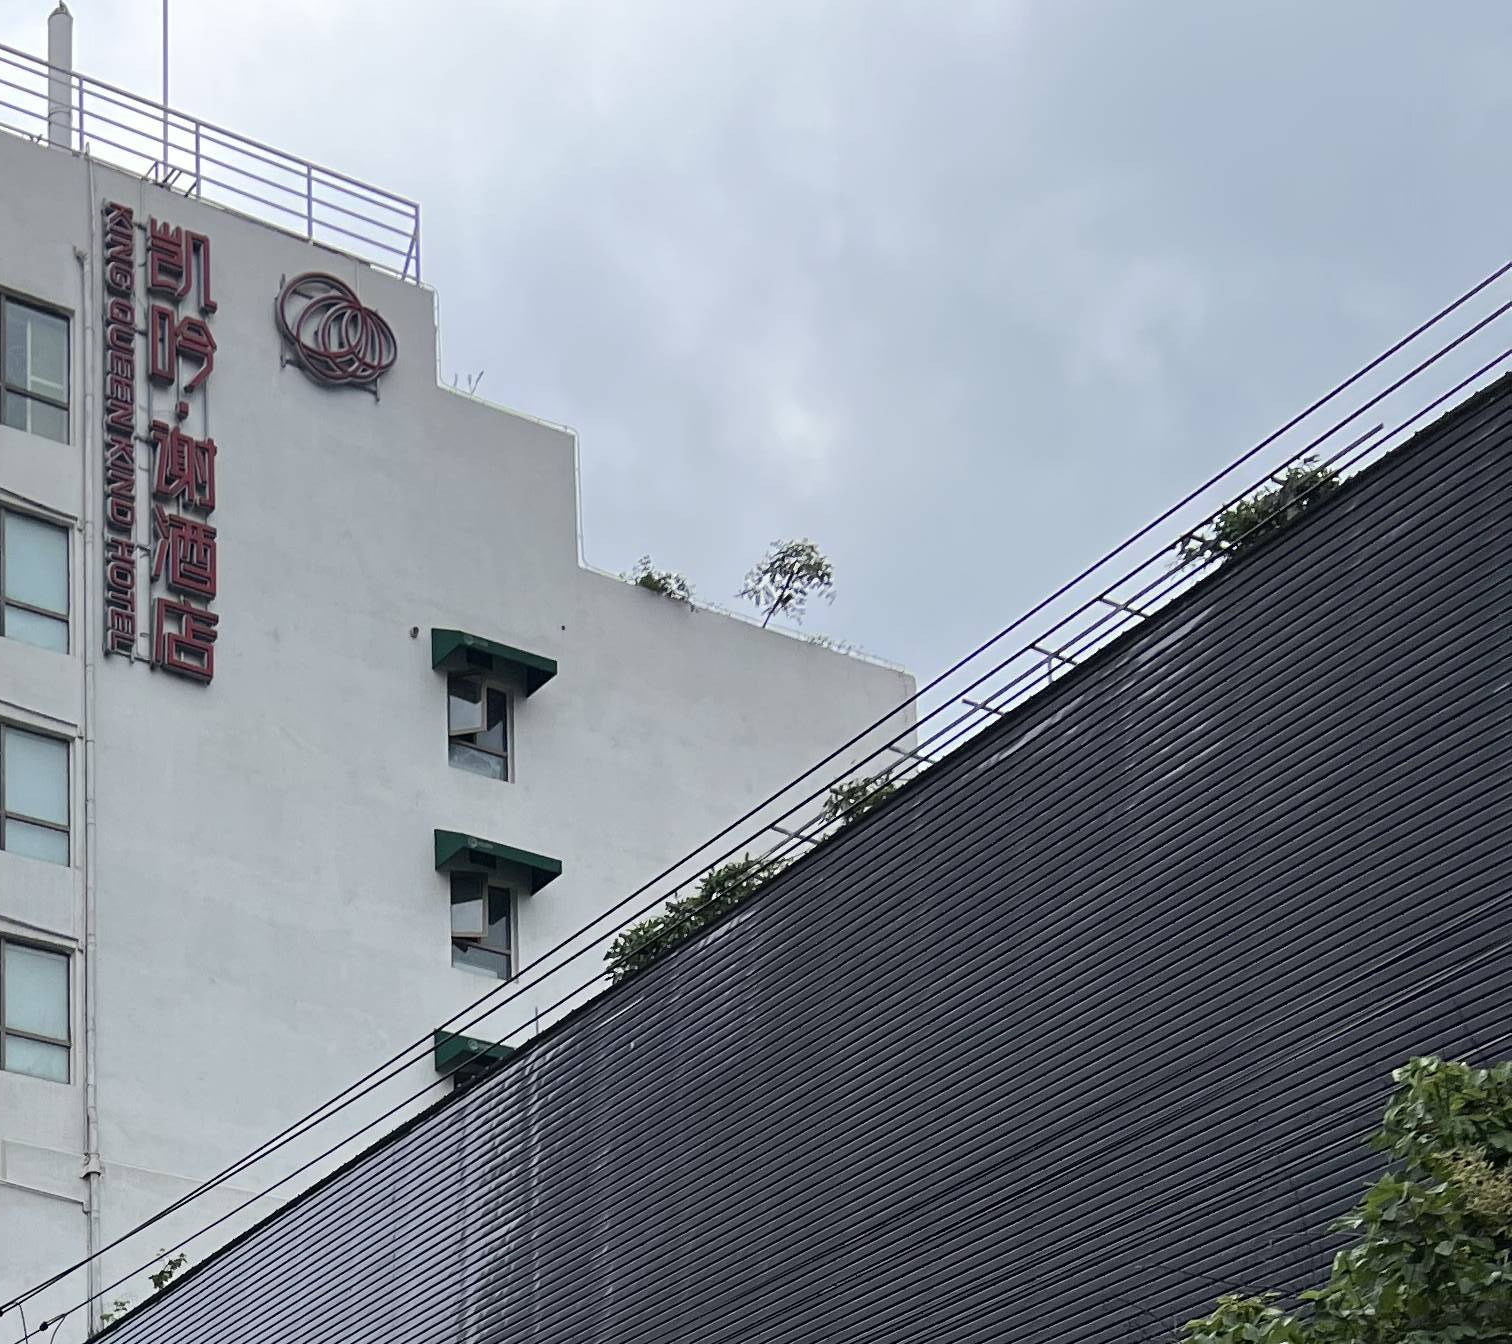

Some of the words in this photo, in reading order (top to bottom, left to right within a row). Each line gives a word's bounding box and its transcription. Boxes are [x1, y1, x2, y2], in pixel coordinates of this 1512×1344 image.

[106, 203, 134, 293] KING
[106, 298, 134, 436] QUEEN
[105, 438, 135, 531] KIND
[104, 536, 136, 654] HOTEL
